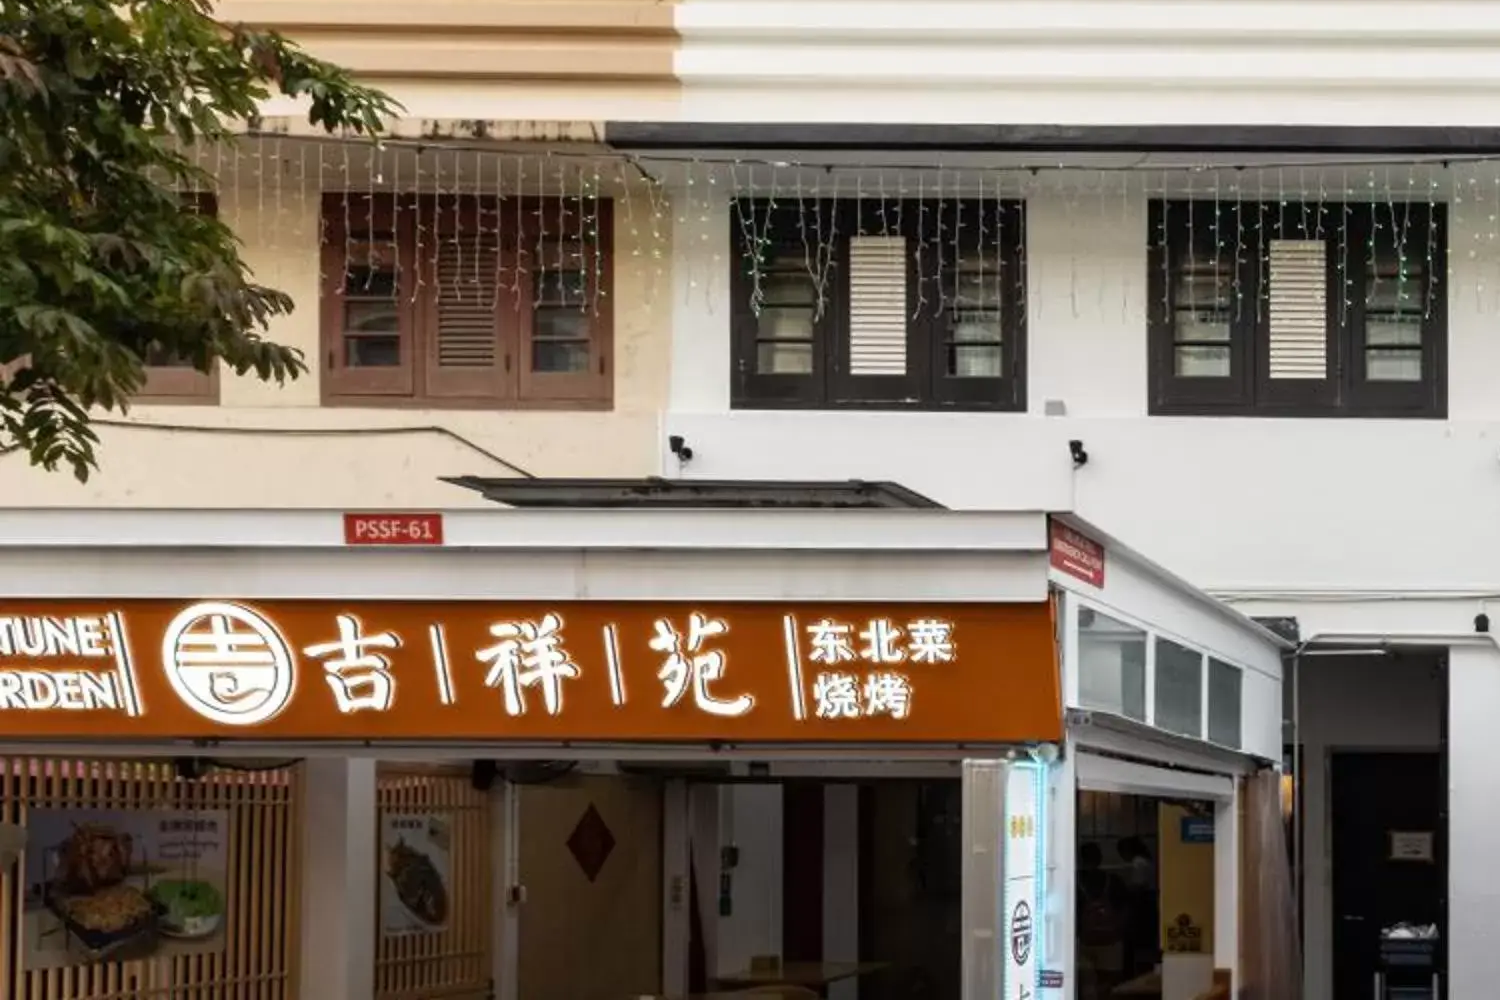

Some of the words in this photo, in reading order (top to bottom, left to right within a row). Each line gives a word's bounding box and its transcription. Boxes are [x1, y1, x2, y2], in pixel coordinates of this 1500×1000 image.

[355, 519, 434, 539] PSSF-61
[806, 618, 956, 664] 东北菜
[813, 672, 912, 719] 烧烤
